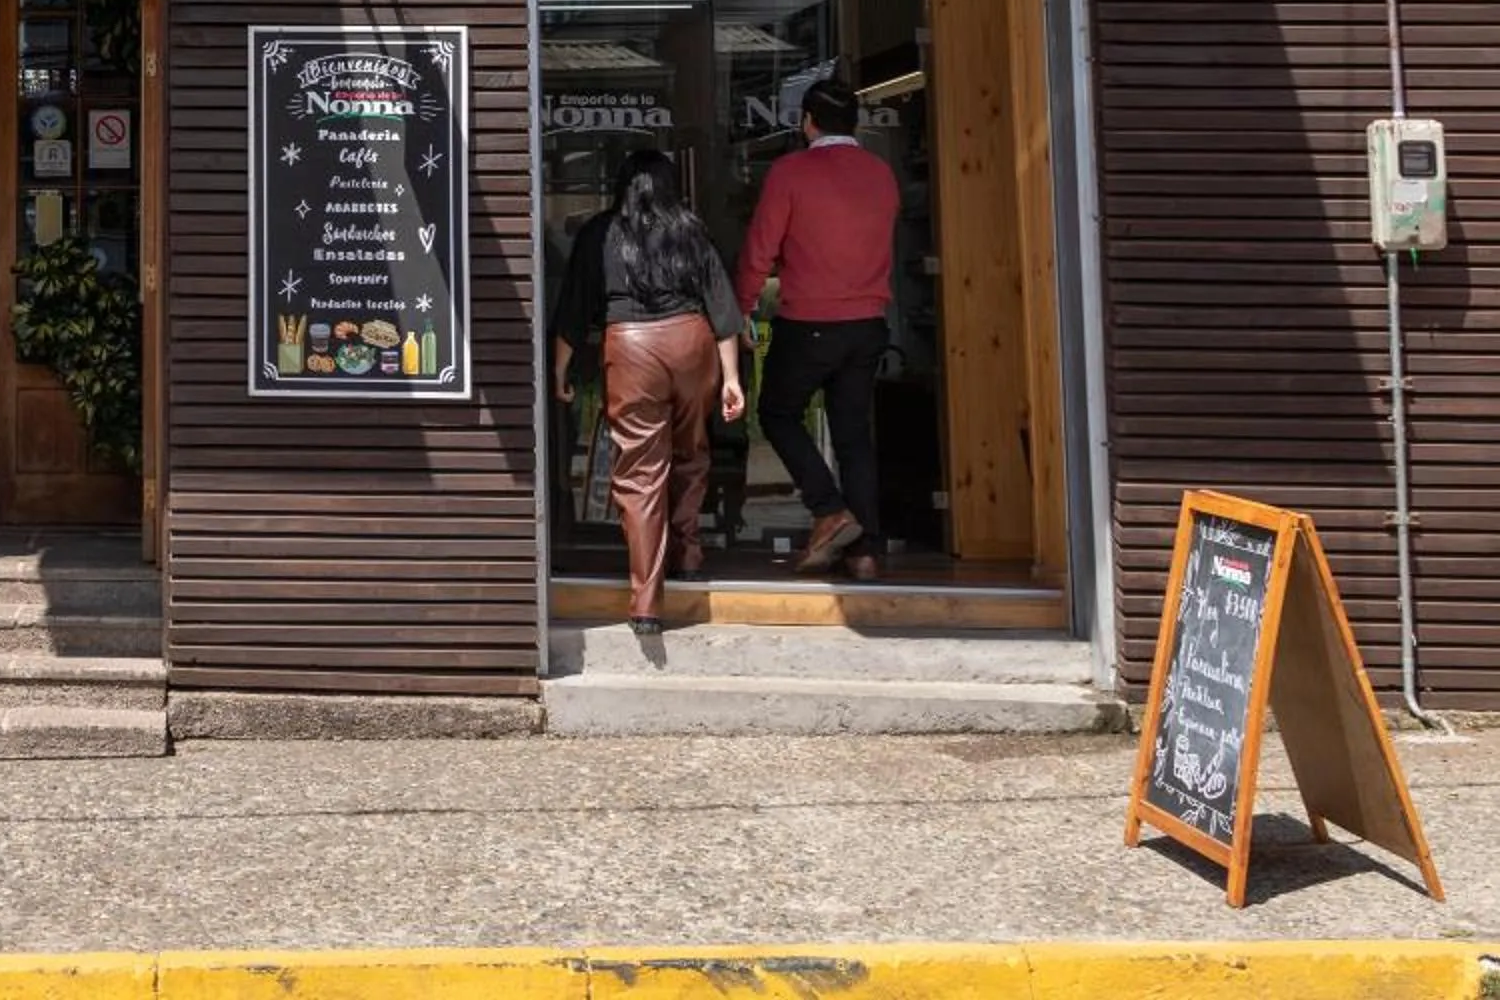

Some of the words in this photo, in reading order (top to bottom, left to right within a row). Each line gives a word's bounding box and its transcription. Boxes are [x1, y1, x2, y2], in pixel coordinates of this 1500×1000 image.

[305, 91, 415, 115] Nonna
[559, 93, 617, 106] Emporio
[619, 93, 638, 105] de
[313, 248, 405, 261] Ensaladas
